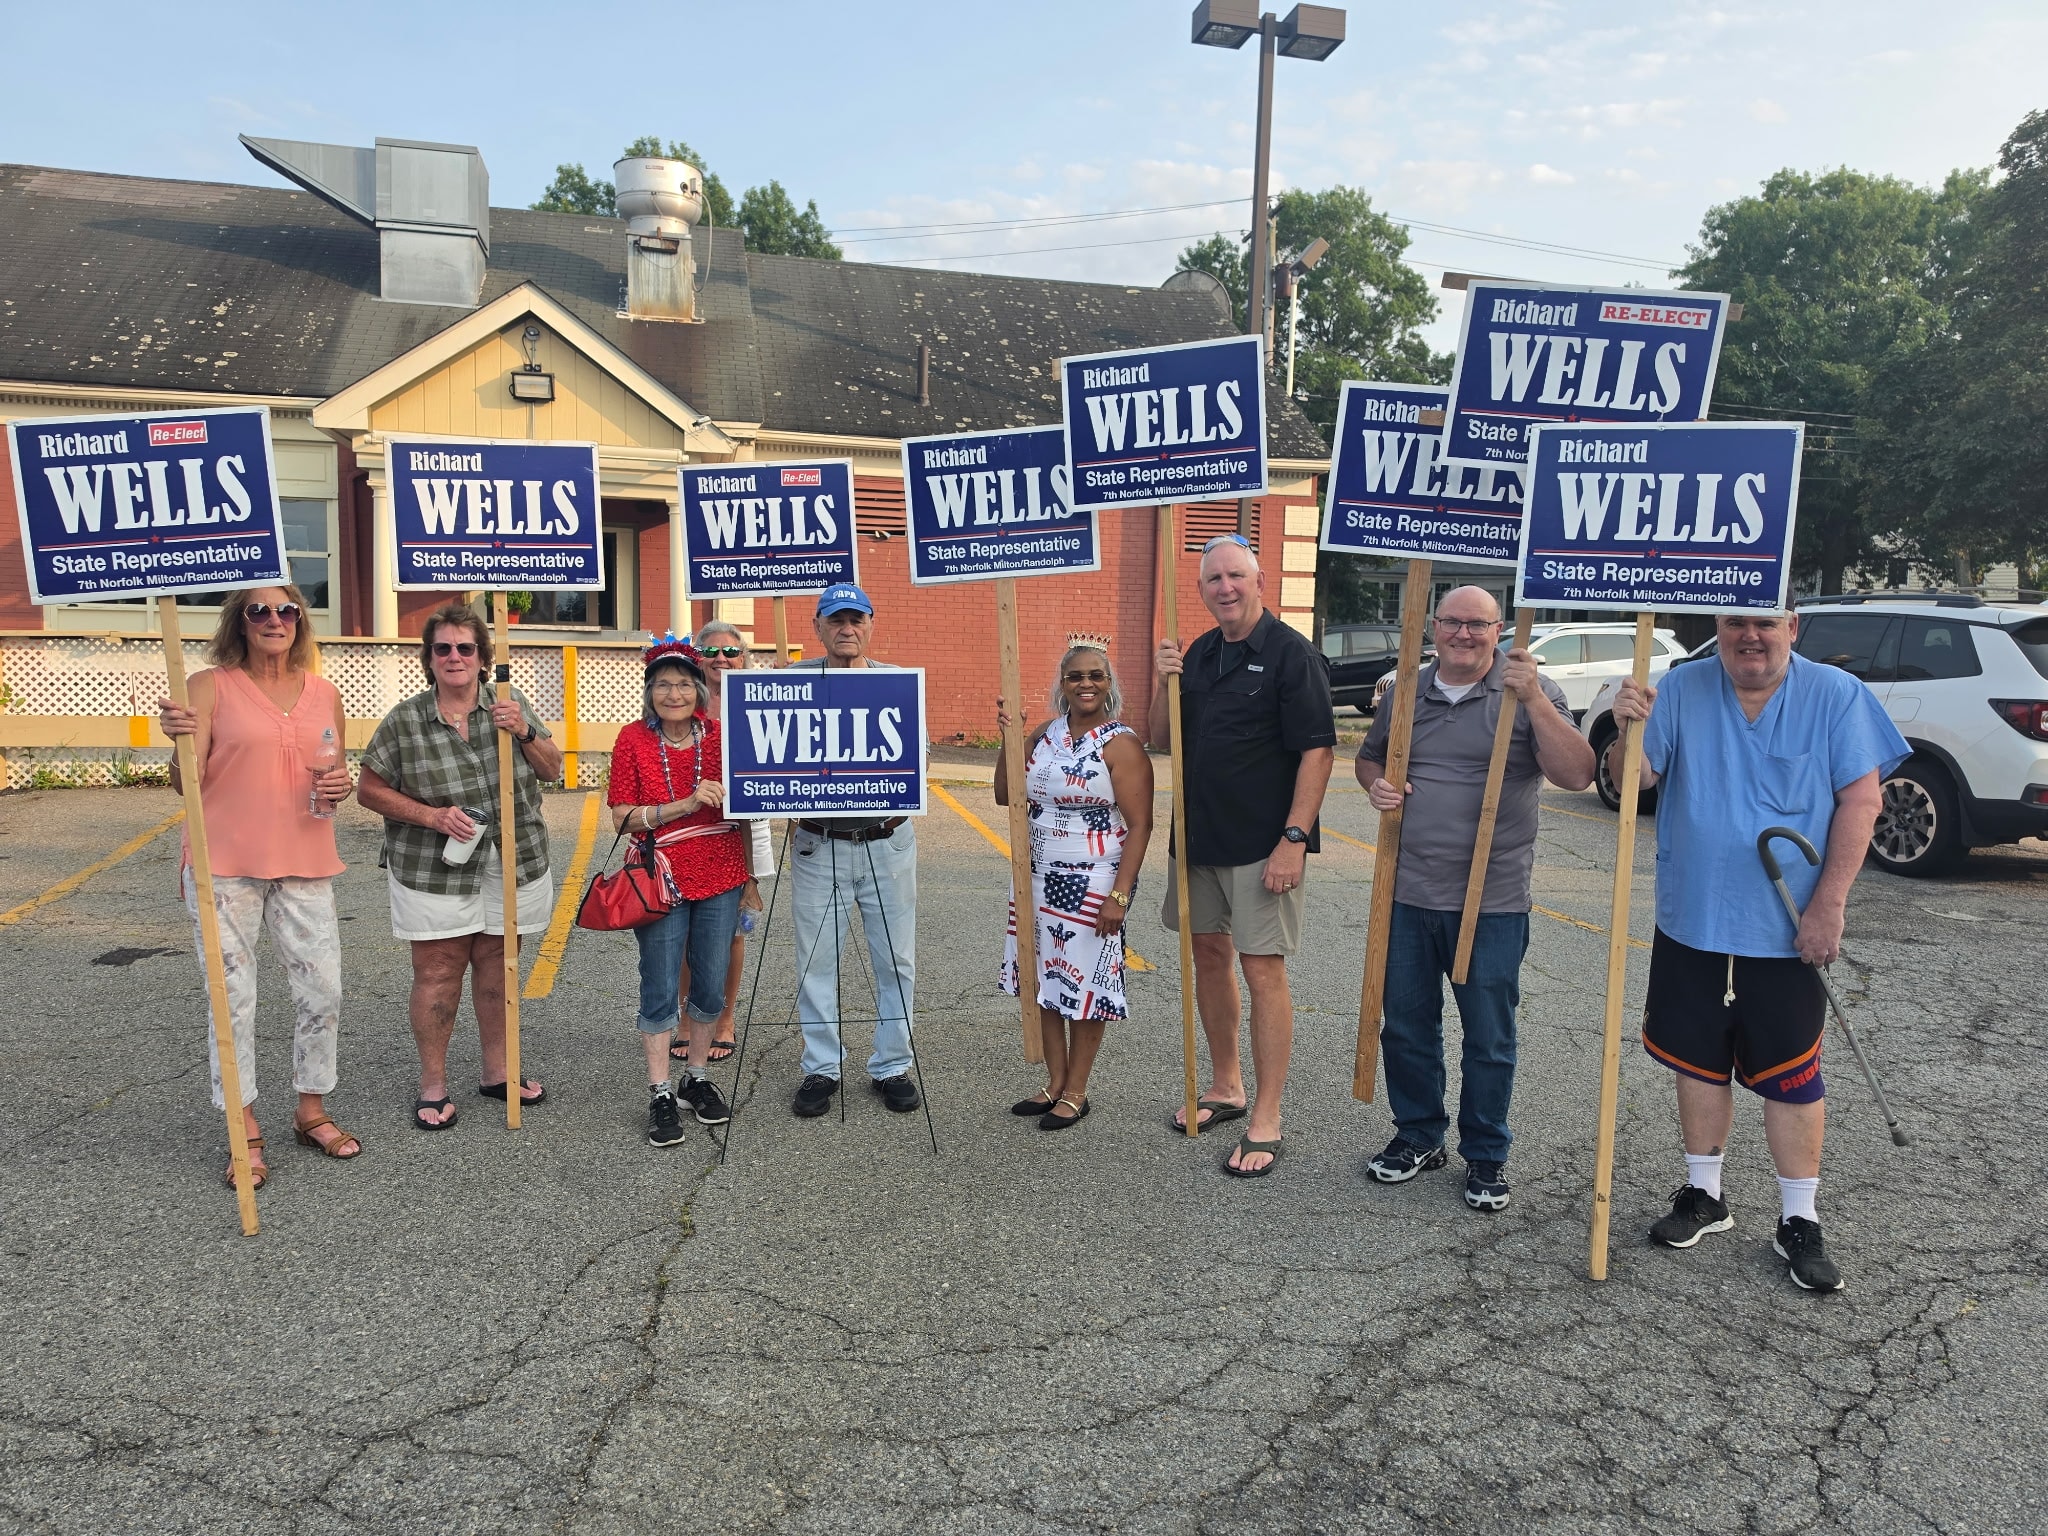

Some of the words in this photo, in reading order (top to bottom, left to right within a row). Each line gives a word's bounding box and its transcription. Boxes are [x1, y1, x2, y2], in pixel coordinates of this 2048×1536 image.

[1491, 298, 1578, 327] Richard
[1603, 305, 1707, 327] RE-ELECT
[1083, 362, 1150, 389] Richard
[1489, 332, 1686, 413] WELLS
[1085, 380, 1243, 453] WELLS
[1364, 398, 1443, 424] Richa
[153, 426, 206, 442] Re-Elect
[1467, 419, 1518, 442] State
[38, 430, 129, 458] Richard
[1485, 447, 1503, 458] 7th
[1557, 439, 1649, 463] Richard
[409, 451, 482, 472] Richard
[923, 445, 987, 469] Richard
[783, 473, 819, 483] Re-Elect
[1086, 470, 1126, 487] State
[1129, 458, 1248, 484] Representative
[44, 455, 251, 534] WELLS
[697, 475, 756, 494] Richard
[1103, 491, 1117, 500] 7th
[1119, 488, 1152, 499] Norfolk
[1155, 481, 1230, 497] Milton/Randolph
[411, 479, 579, 536] WELLS
[1556, 472, 1766, 544] WELLS
[700, 494, 837, 550] WELLS
[1346, 510, 1392, 530] State
[1397, 514, 1521, 541] Representativ
[928, 545, 966, 561] State
[970, 537, 1080, 559] Representative
[1363, 535, 1379, 545] 7th
[1381, 537, 1419, 549] Norfolk
[1422, 540, 1509, 557] Milton/Randolph
[52, 554, 107, 575] State
[112, 543, 262, 575] Representative
[412, 551, 456, 568] State
[461, 552, 584, 570] Representative
[701, 564, 736, 579] State
[740, 560, 842, 579] Representative
[945, 565, 959, 573] 7th
[961, 562, 991, 572] Norfolk
[993, 558, 1064, 570] Milton/Randolph
[77, 579, 97, 590] 7th
[100, 572, 144, 588] Norfolk
[147, 568, 243, 586] Milton/Randolph
[432, 573, 447, 581] 7th
[450, 573, 485, 582] Norfolk
[488, 573, 567, 583] Milton/Randolph
[1542, 560, 1597, 581] State
[1602, 562, 1763, 586] Representative
[717, 582, 730, 590] 7th
[731, 581, 761, 590] Norfolk
[762, 579, 828, 590] Milton/Randolph
[832, 590, 857, 599] PAPA
[1563, 587, 1582, 598] 7th
[1585, 588, 1630, 600] Norfolk
[1633, 589, 1737, 604] Milton/Randolph
[744, 682, 813, 702] Richard
[745, 707, 903, 764] WELLS
[743, 781, 784, 796] State
[789, 779, 907, 798] Representative
[761, 802, 776, 810] 7th
[778, 801, 812, 810] Norfolk
[814, 800, 890, 809] Milton/Randolph
[1054, 820, 1069, 829] THE
[1091, 971, 1123, 993] BRAV
